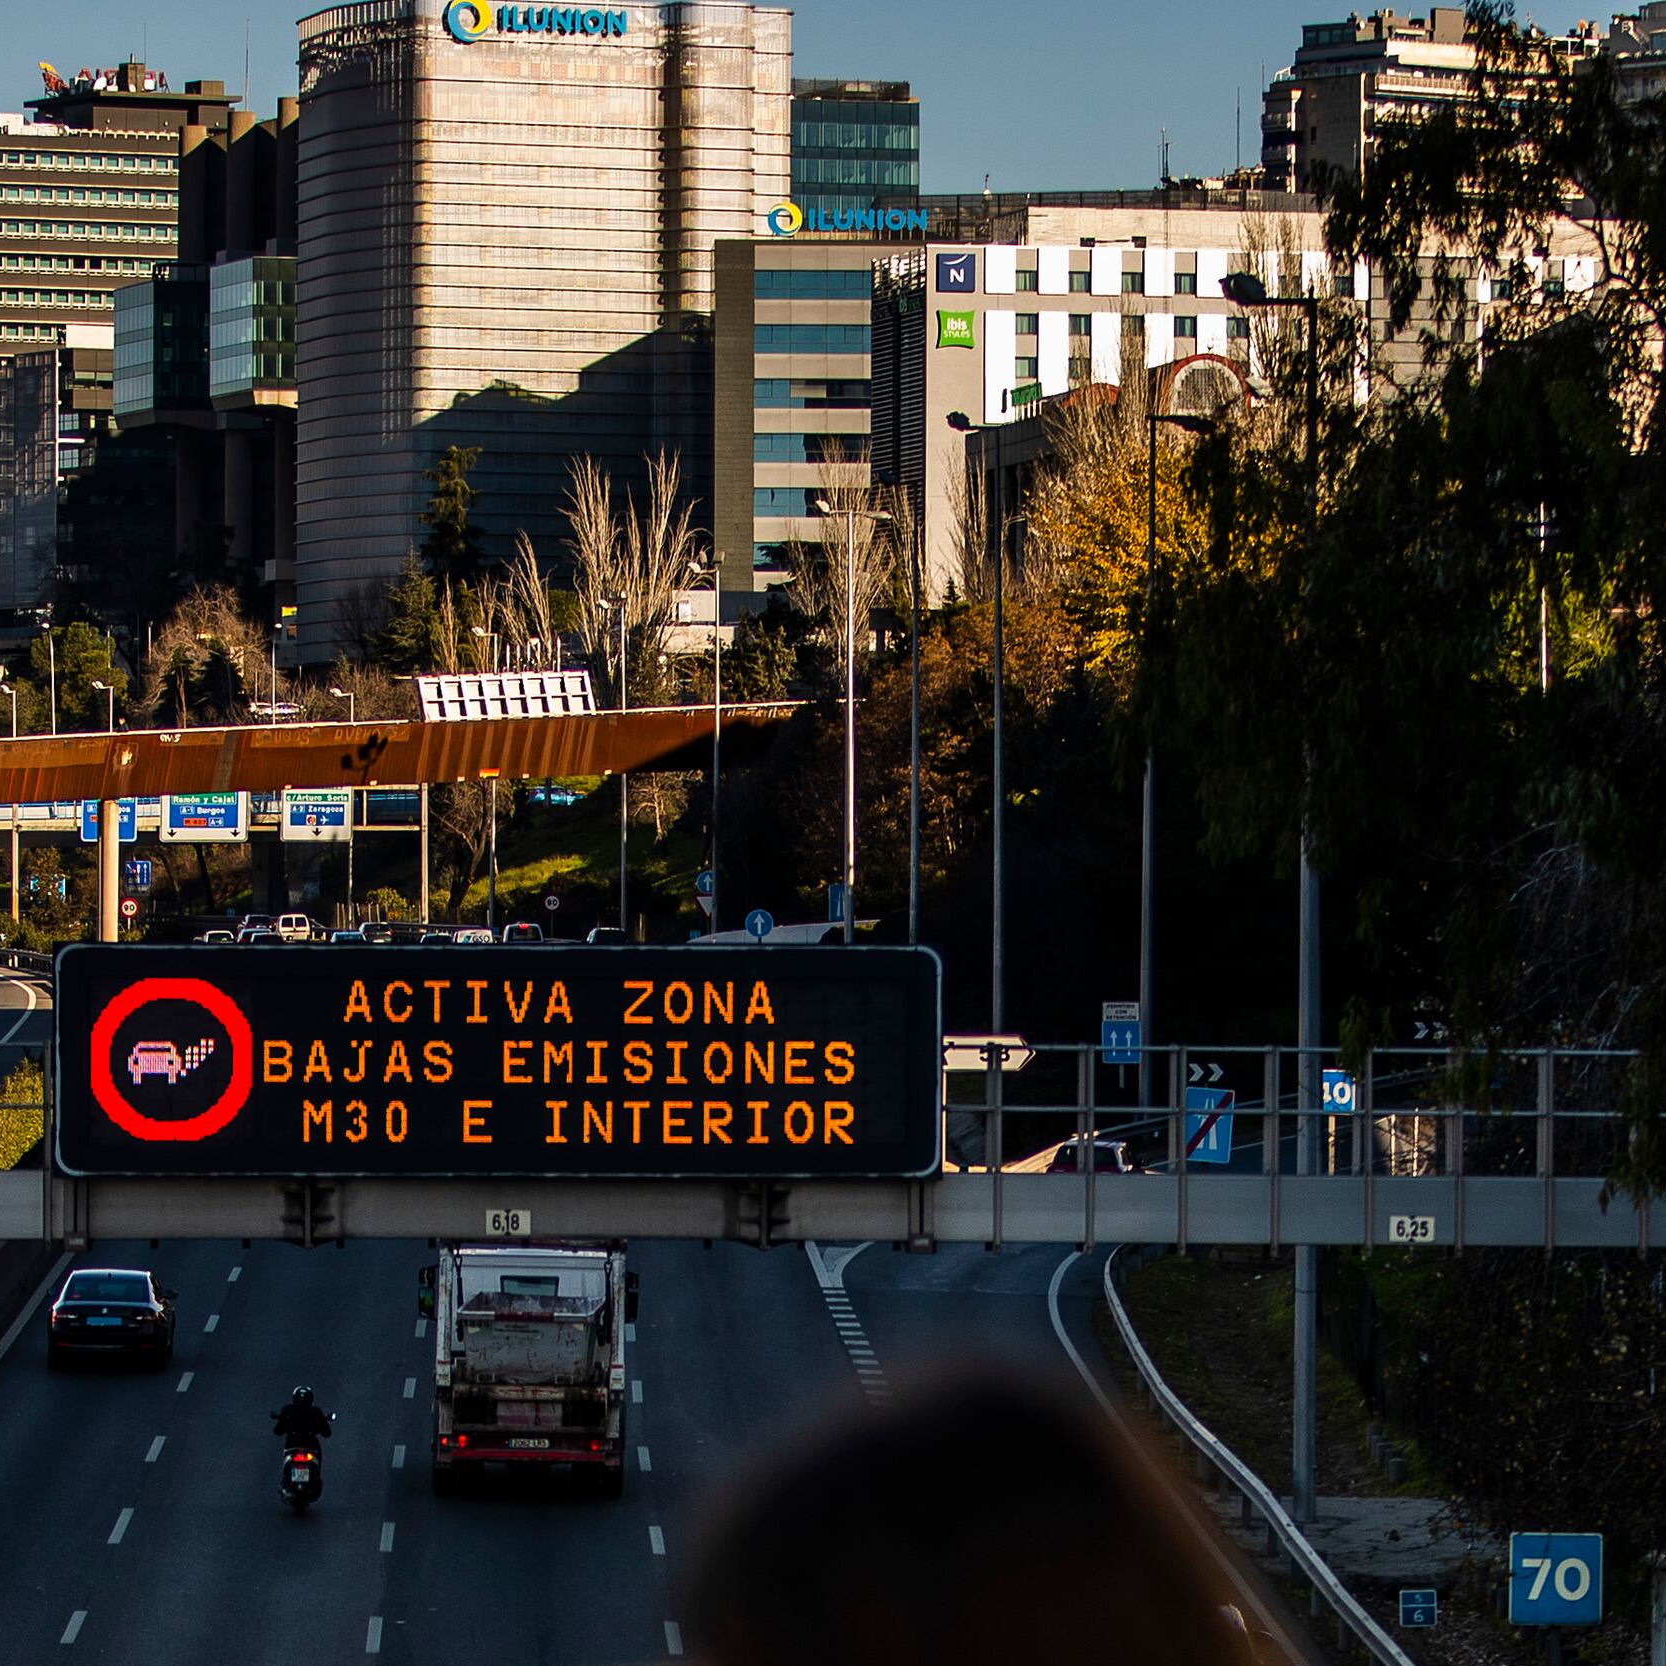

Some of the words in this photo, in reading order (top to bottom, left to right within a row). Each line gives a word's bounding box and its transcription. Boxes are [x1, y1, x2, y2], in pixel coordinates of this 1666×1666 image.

[501, 5, 628, 35] ILUNION
[808, 208, 928, 231] ILUNION
[949, 268, 965, 283] N
[197, 806, 226, 815] Burgos
[308, 805, 344, 814] Zaragoza
[343, 980, 574, 1024] ACTIVA
[623, 980, 775, 1024] ZONA
[263, 1040, 454, 1084] BAJAS
[503, 1040, 855, 1085] EMISIONES
[303, 1100, 408, 1144] M30
[463, 1100, 493, 1144] E
[545, 1100, 855, 1145] INTERIOR
[492, 1213, 520, 1232] 6,18
[1396, 1220, 1429, 1238] 6,25
[1521, 1557, 1591, 1601] 70
[1413, 1609, 1425, 1623] 6
